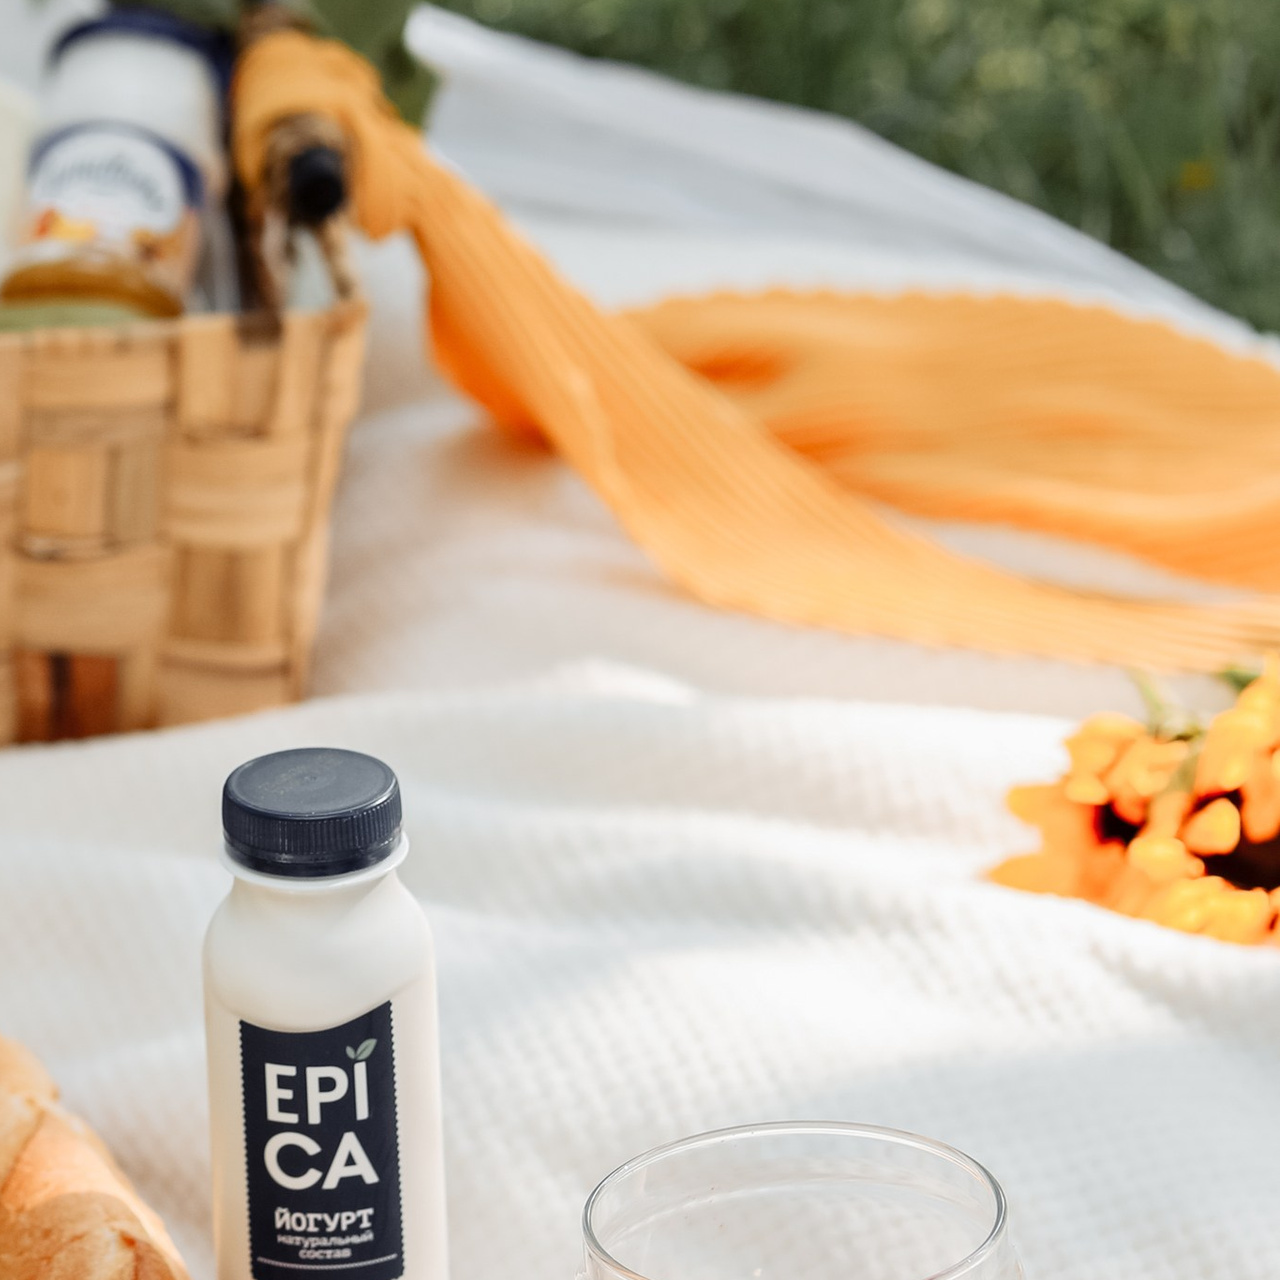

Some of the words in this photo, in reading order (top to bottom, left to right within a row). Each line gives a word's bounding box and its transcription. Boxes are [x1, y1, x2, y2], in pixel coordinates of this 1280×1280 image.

[264, 1131, 380, 1190] CA
[277, 1230, 375, 1249] натуральный
[298, 1247, 353, 1260] состав
